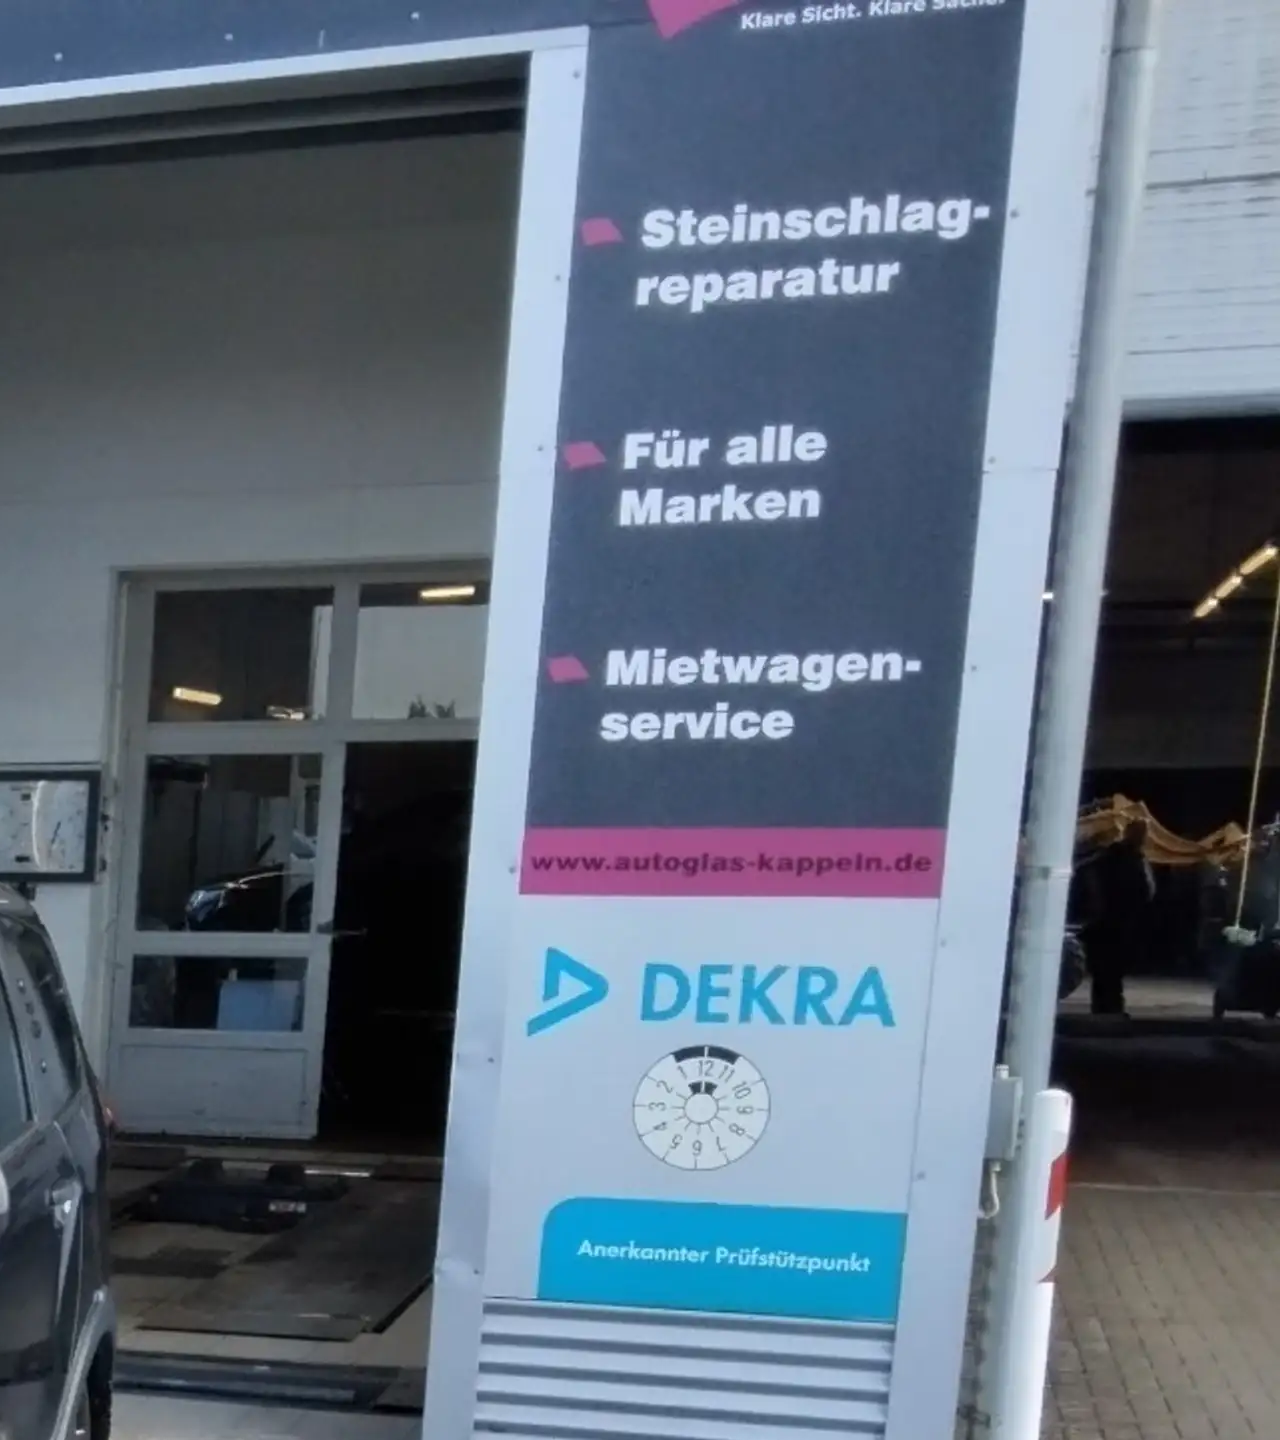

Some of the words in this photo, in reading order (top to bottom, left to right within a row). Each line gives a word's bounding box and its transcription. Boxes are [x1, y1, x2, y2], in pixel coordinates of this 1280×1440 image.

[741, 11, 797, 30] Klare
[801, 5, 861, 24] Sicht.
[869, 0, 930, 17] Klare
[641, 194, 990, 248] Steinschlag-
[635, 258, 900, 312] reparatur
[622, 430, 709, 470] Für
[725, 425, 829, 465] alle
[618, 484, 822, 526] Marken
[605, 648, 922, 691] Mietwagen-
[600, 702, 796, 742] service
[530, 852, 934, 878] www.autoglas-kappeln.de
[640, 962, 896, 1028] DEKRA
[697, 1059, 715, 1077] 12
[718, 1064, 736, 1083] 11
[655, 1079, 675, 1094] 2
[731, 1081, 752, 1100] 10
[648, 1101, 667, 1112] 3
[728, 1122, 746, 1137] 8
[576, 1239, 709, 1264] Anerkannter
[715, 1246, 871, 1275] Prüfstützpunkt
